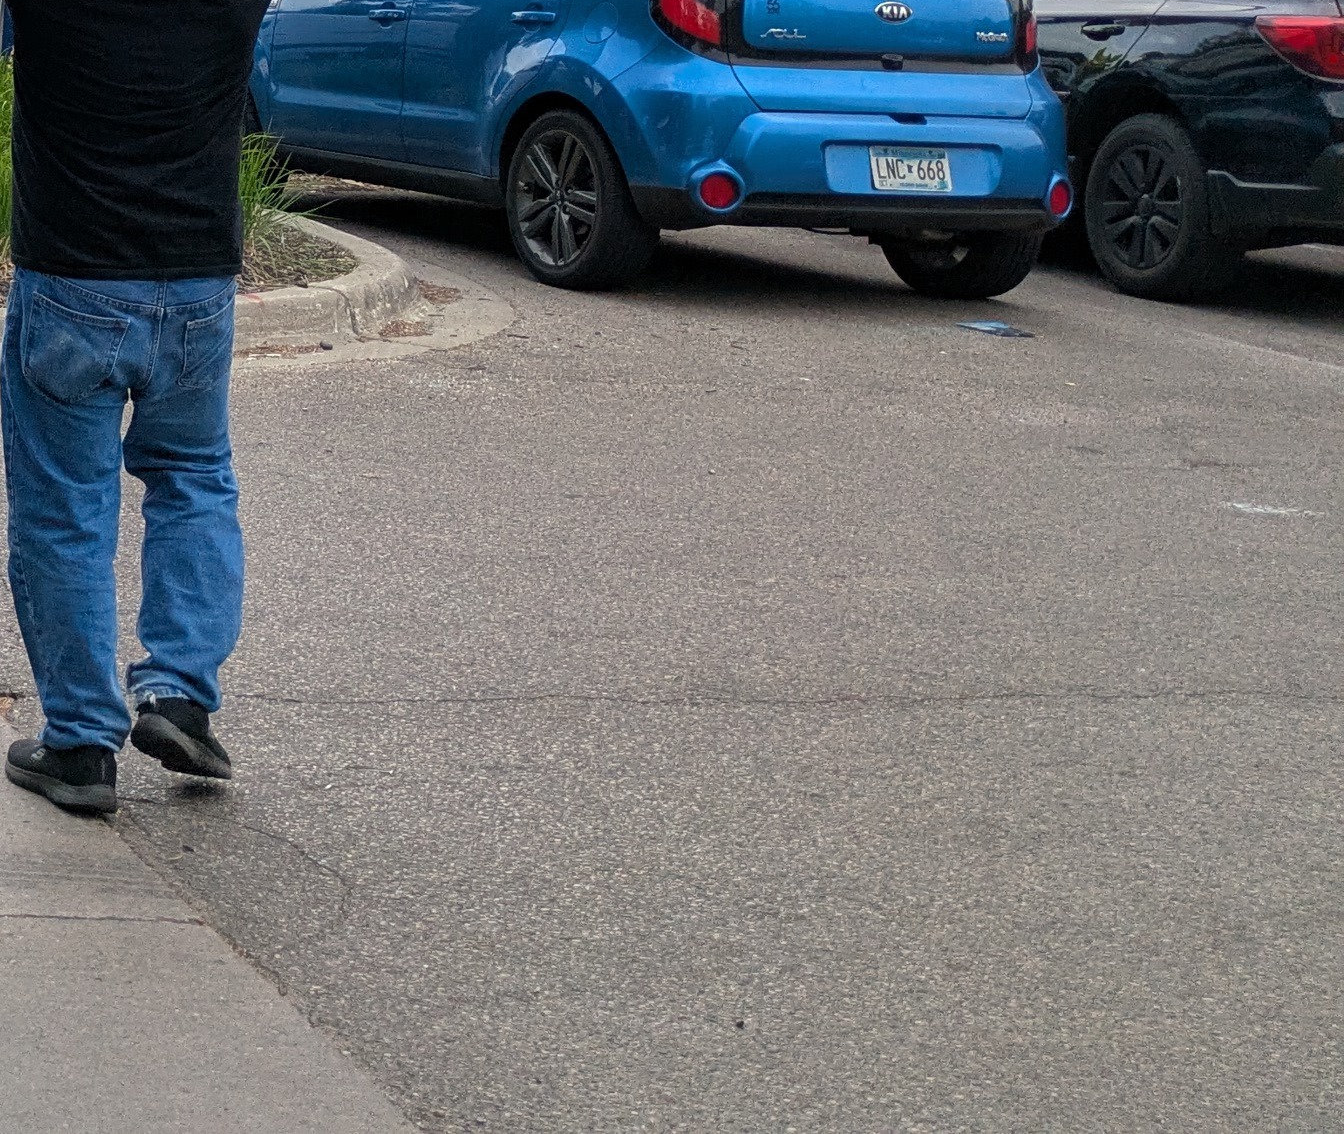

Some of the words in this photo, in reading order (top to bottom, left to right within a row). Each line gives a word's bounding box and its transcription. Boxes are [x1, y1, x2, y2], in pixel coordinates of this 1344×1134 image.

[882, 5, 908, 19] KIA
[875, 157, 907, 180] LNC
[917, 159, 946, 181] 668
